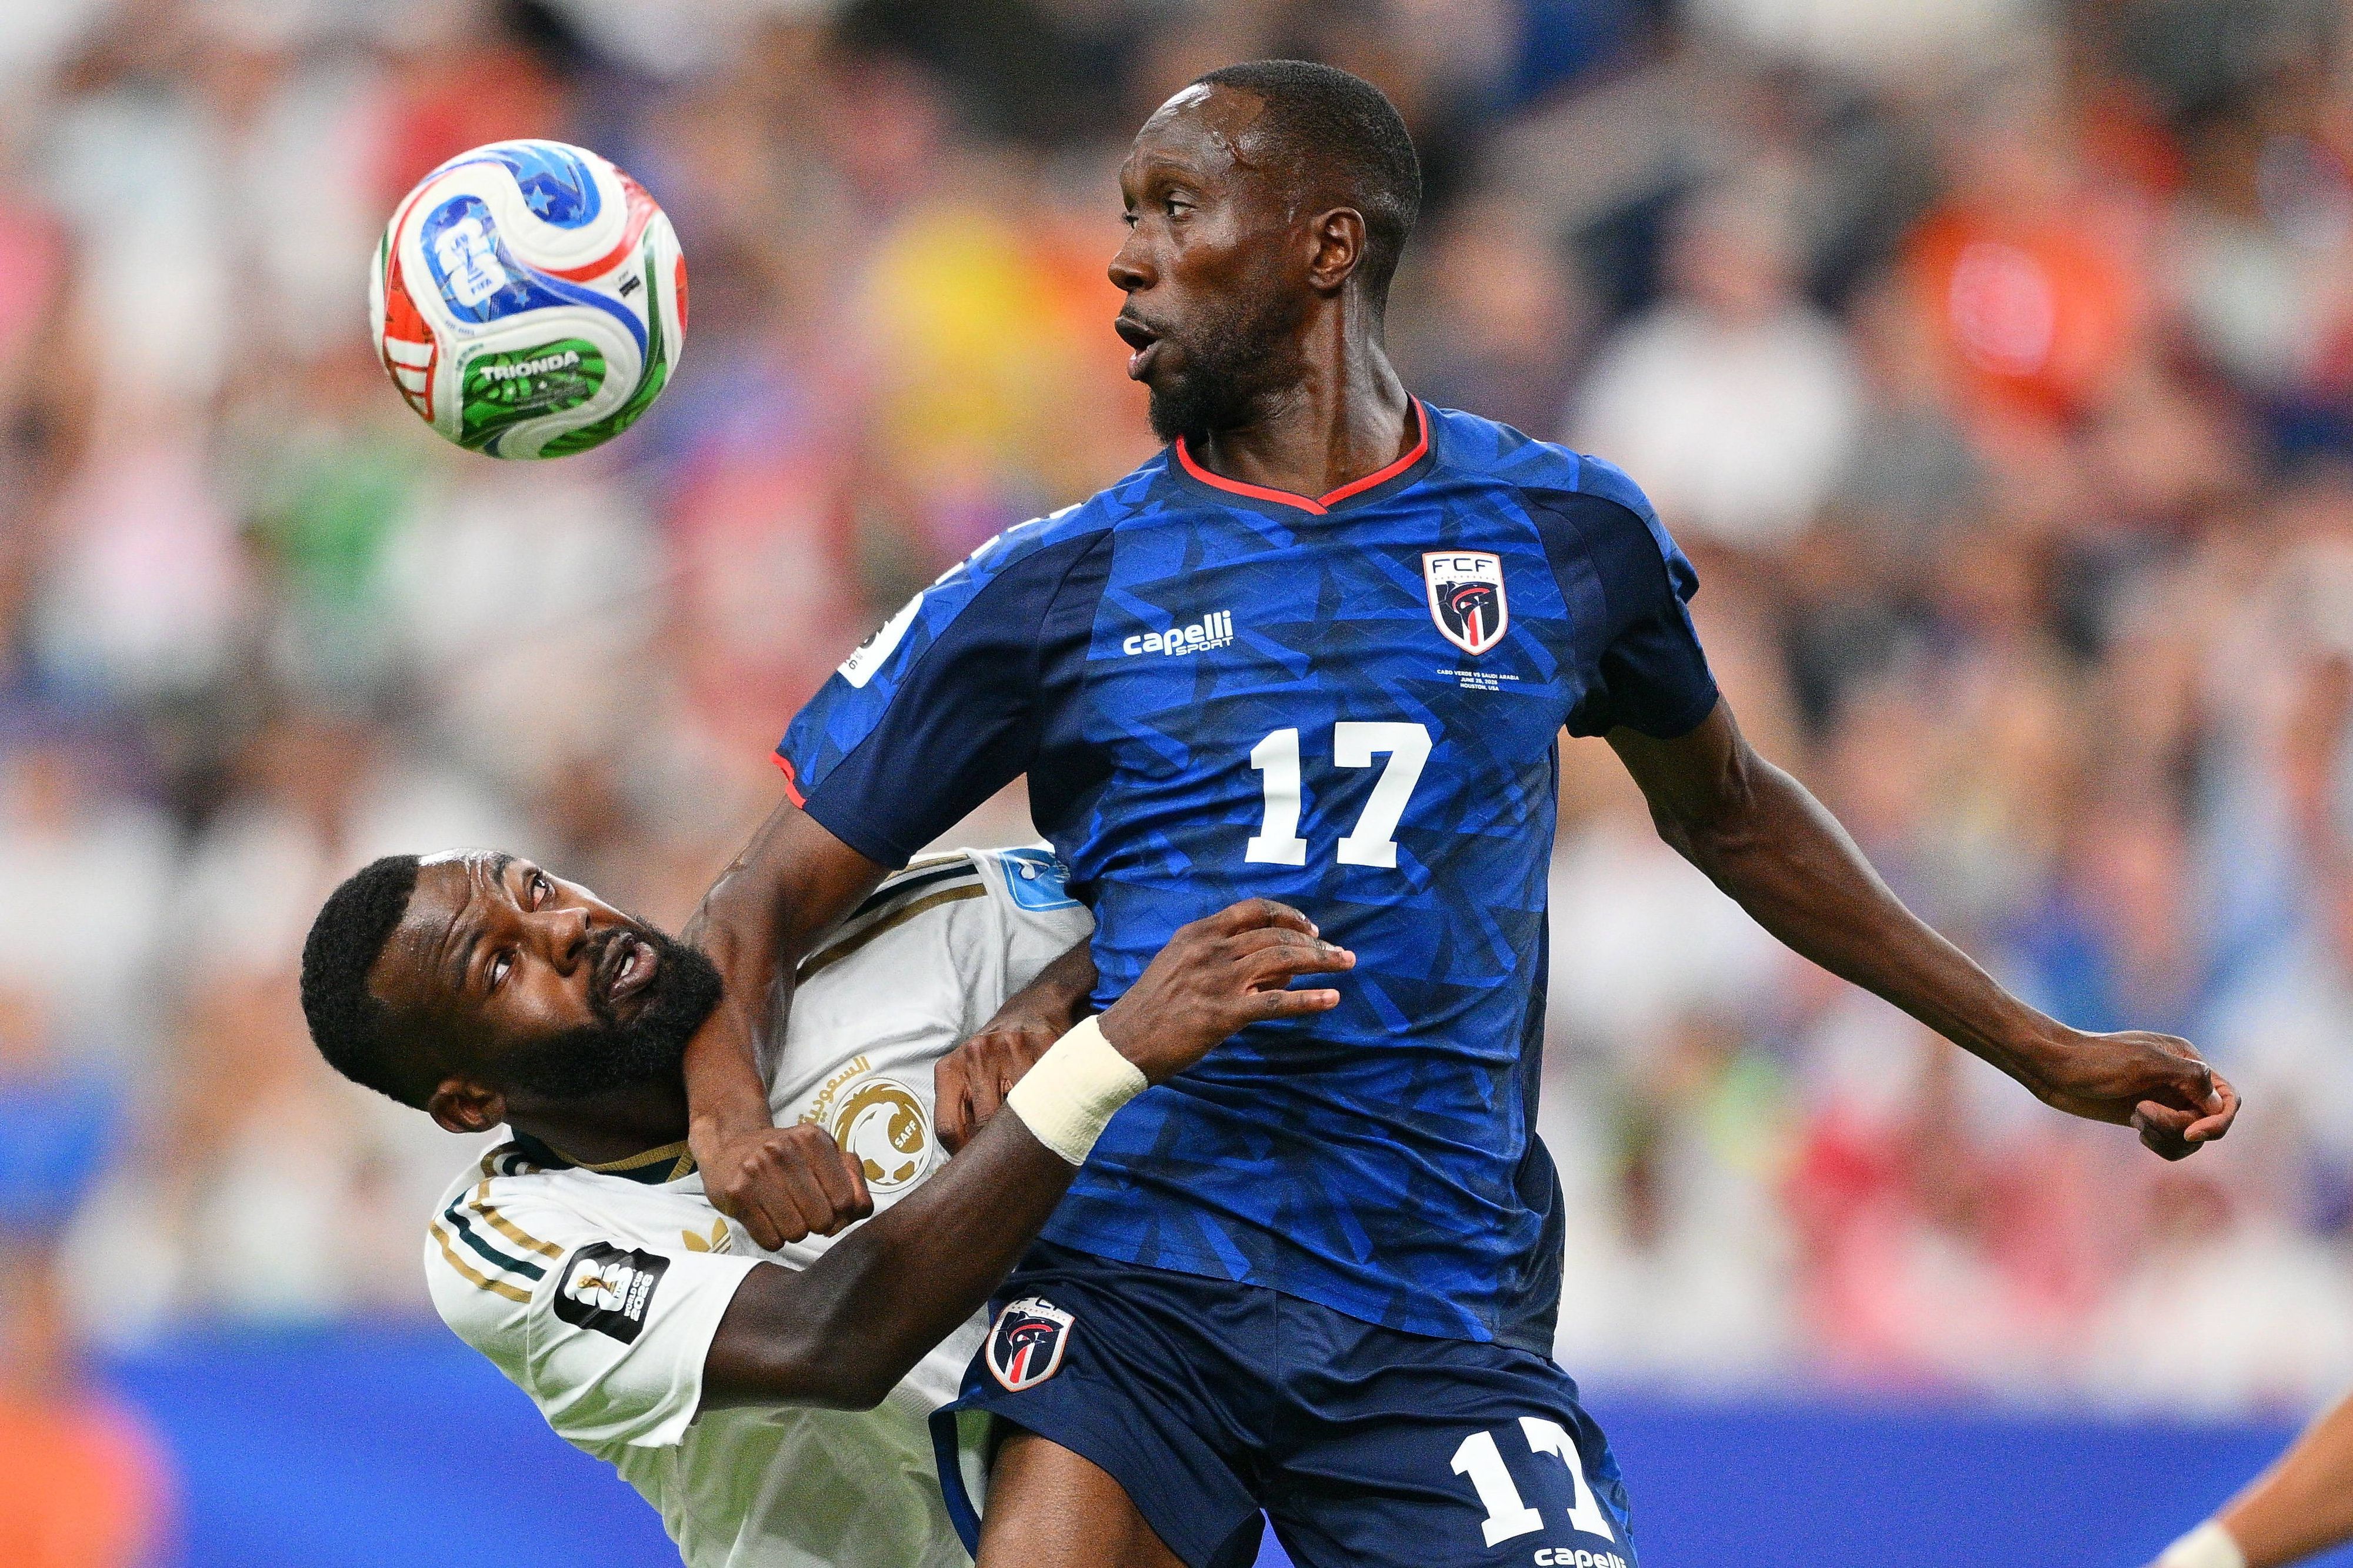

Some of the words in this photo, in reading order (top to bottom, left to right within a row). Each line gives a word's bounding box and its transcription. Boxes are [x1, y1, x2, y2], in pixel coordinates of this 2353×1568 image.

[480, 351, 580, 381] TRIONDA
[1432, 558, 1493, 573] FCF
[1123, 610, 1233, 656] capelli
[1175, 636, 1234, 656] SPORT
[1244, 721, 1433, 868] 17
[894, 1119, 917, 1148] SAFF
[624, 1287, 637, 1317] WORLD
[632, 1271, 644, 1287] CUP
[630, 1274, 654, 1322] 2026
[1450, 1416, 1615, 1549] 17
